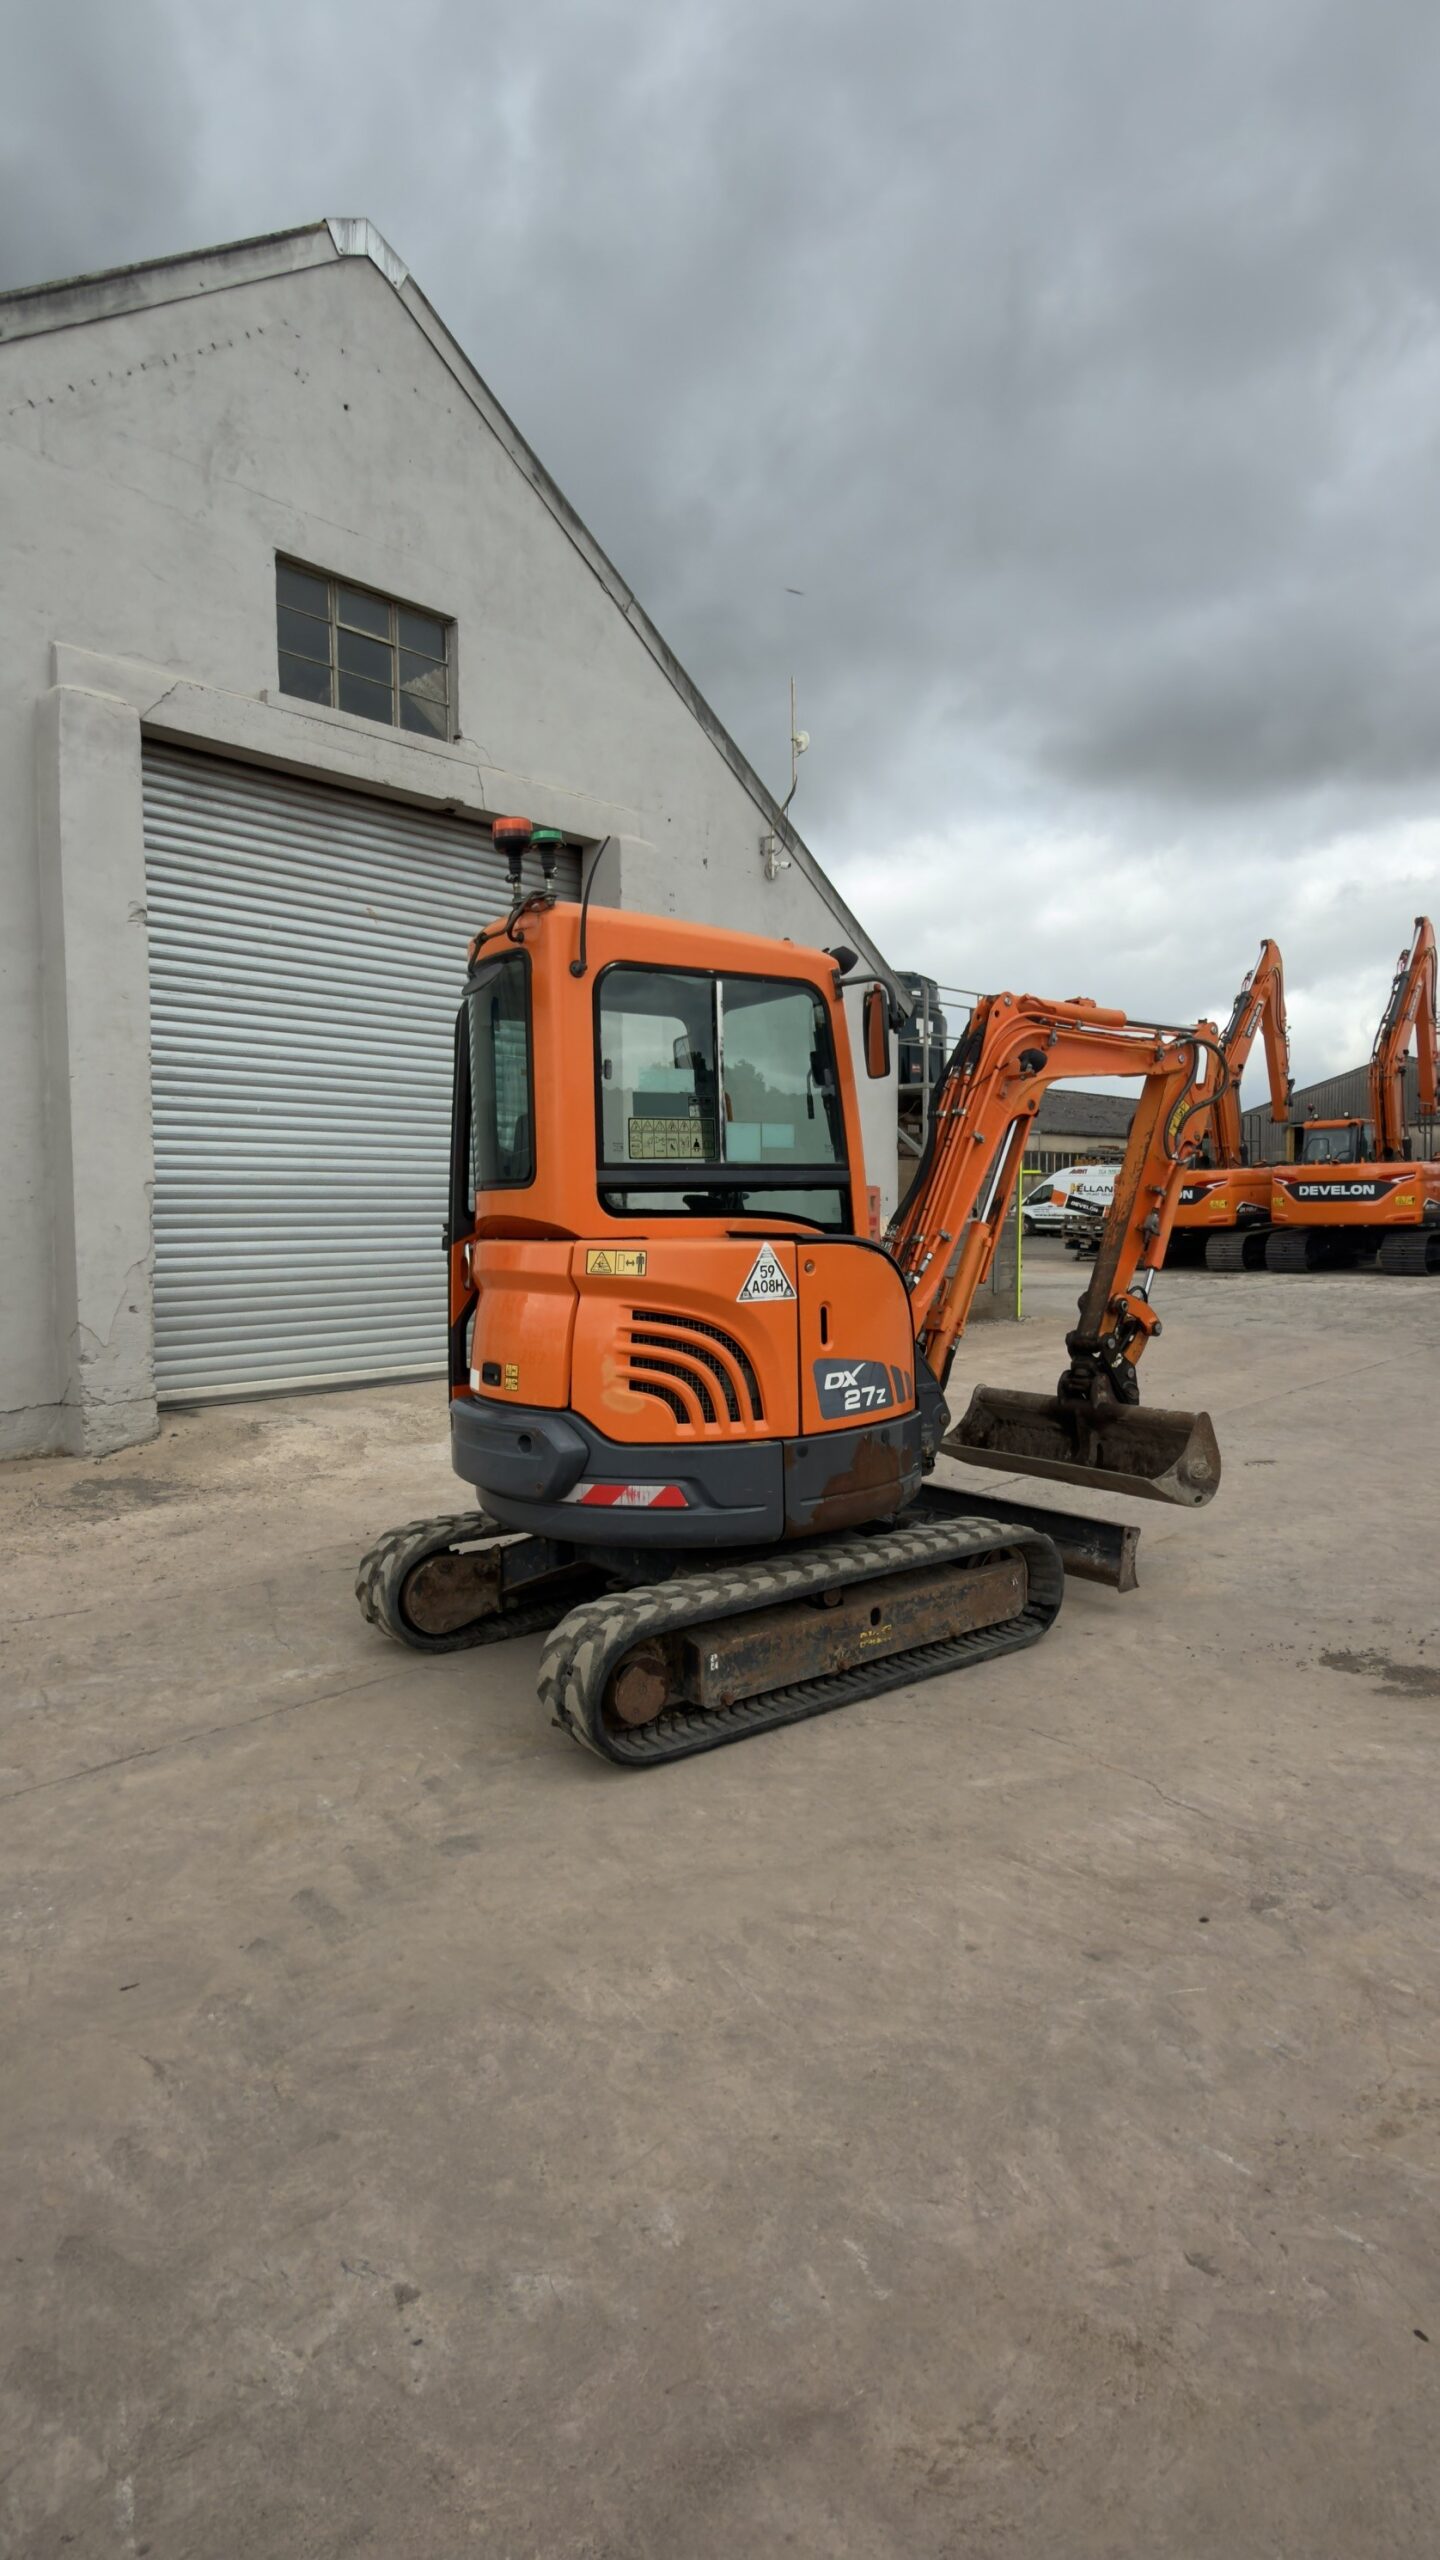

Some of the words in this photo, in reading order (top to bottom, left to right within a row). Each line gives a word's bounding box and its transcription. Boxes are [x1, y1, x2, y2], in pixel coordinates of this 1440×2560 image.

[1299, 1184, 1376, 1196] DEVELON
[760, 1264, 776, 1279] 59
[824, 1362, 866, 1391] DX
